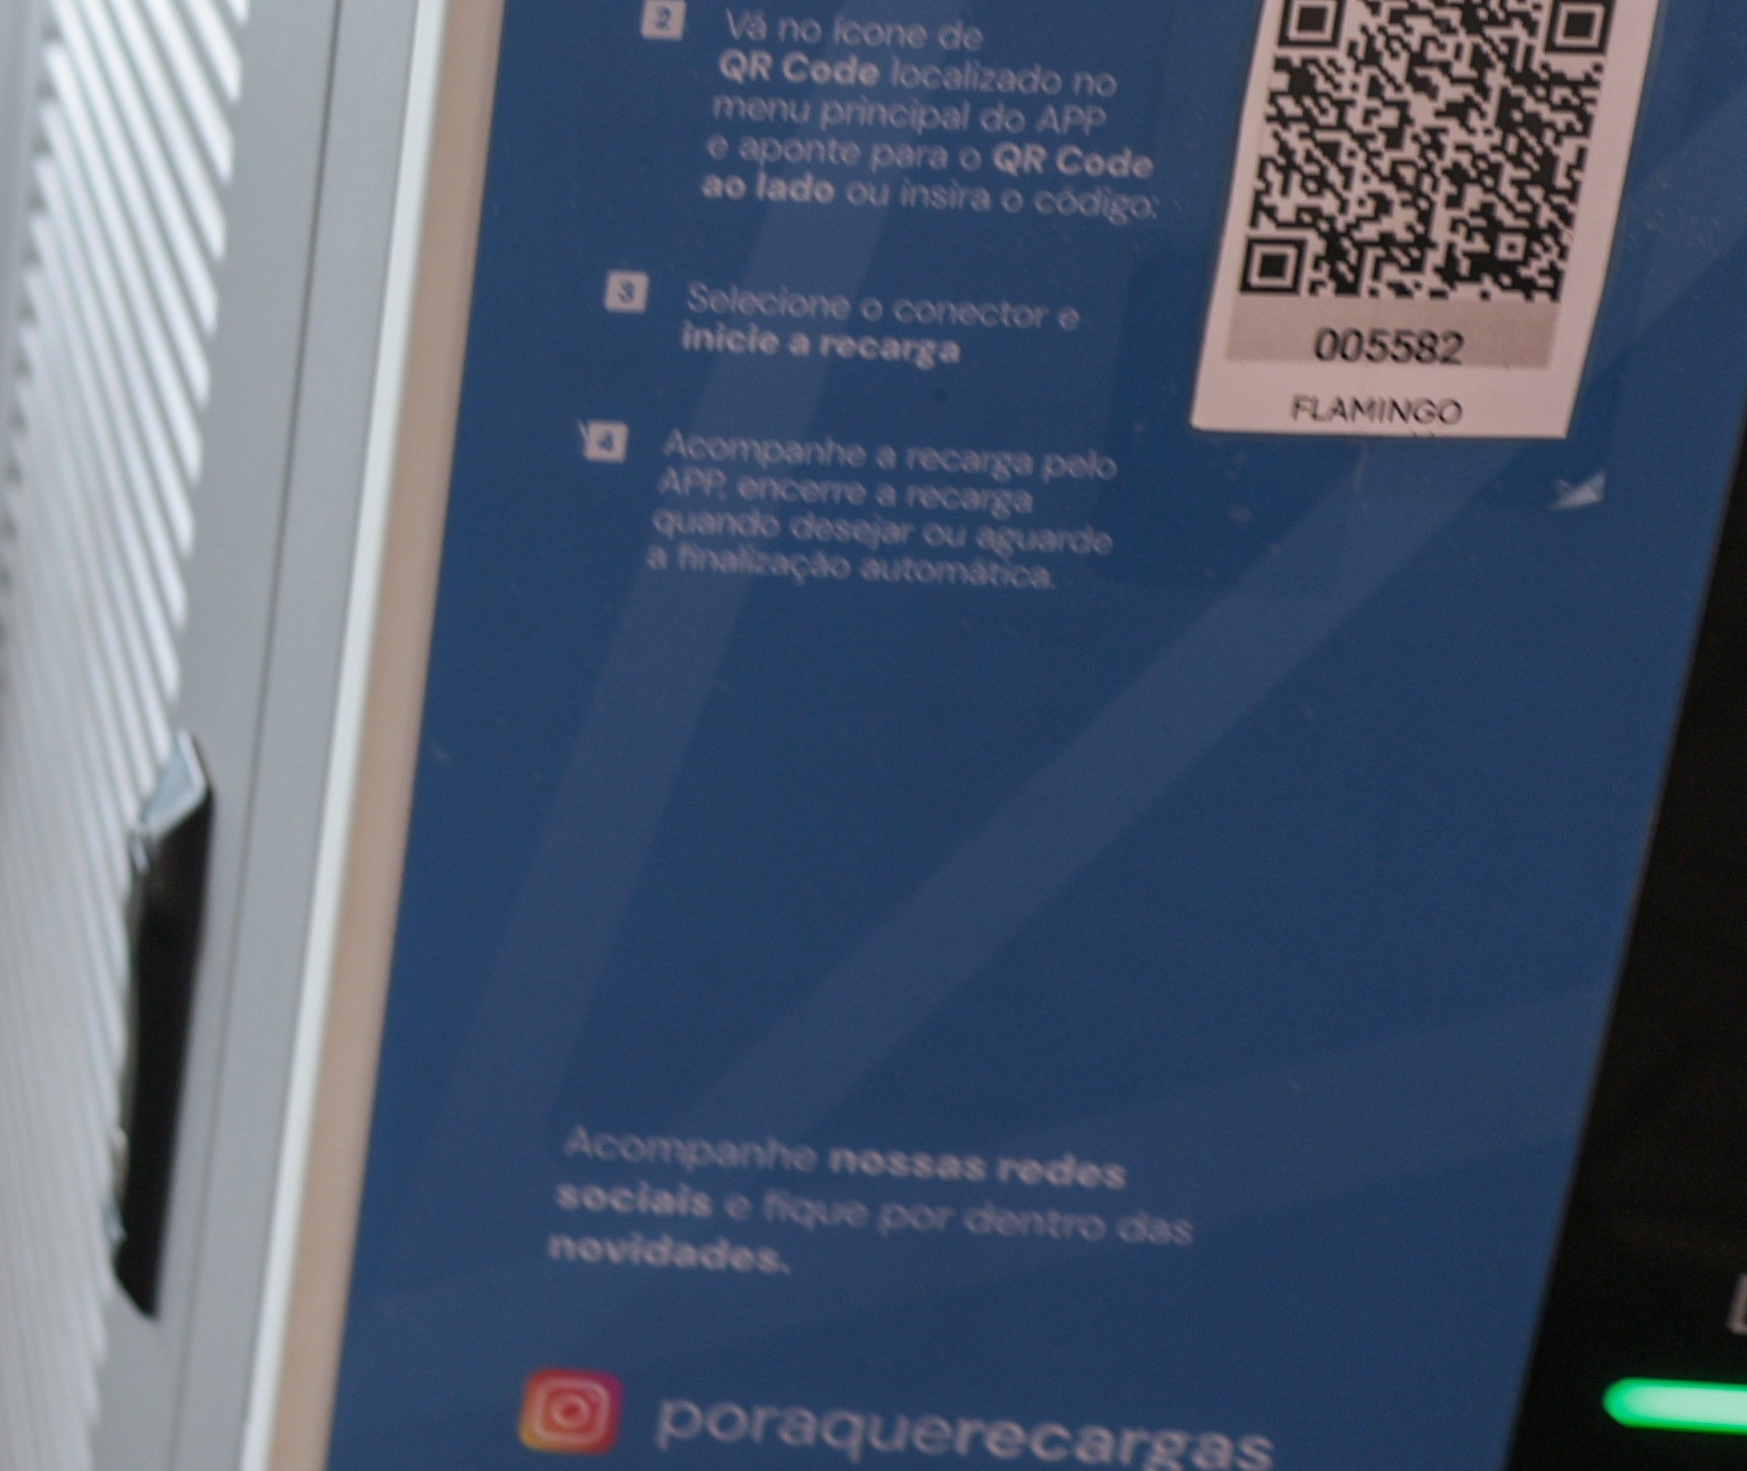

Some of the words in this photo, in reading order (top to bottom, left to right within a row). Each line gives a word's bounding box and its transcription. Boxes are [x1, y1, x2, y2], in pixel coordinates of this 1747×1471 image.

[778, 16, 821, 44] no
[939, 18, 984, 50] de
[719, 50, 772, 83] QR
[783, 53, 879, 87] Code
[891, 56, 1061, 94] localizado
[1072, 69, 1116, 97] no
[713, 96, 809, 124] menu
[820, 98, 969, 136] principal
[980, 99, 1025, 133] do
[1037, 105, 1107, 135] APP
[708, 135, 728, 160] e
[740, 136, 861, 171] aponte
[871, 139, 948, 170] para
[960, 145, 982, 169] o
[993, 143, 1046, 175] QR
[1057, 143, 1154, 179] Code
[703, 174, 746, 199] ao
[755, 169, 835, 203] lado
[847, 176, 890, 204] ou
[901, 178, 991, 211] insira
[1001, 186, 1023, 213] o
[687, 282, 849, 319] Selecione
[861, 296, 883, 321] o
[894, 295, 1048, 329] conector
[1058, 306, 1079, 329] e
[682, 321, 778, 355] inicie
[790, 331, 809, 356] a
[820, 334, 960, 370] recarga
[1314, 328, 1464, 364] 005582
[1292, 394, 1462, 424] FLAMINGO
[662, 429, 866, 470] Acompanhe
[875, 445, 896, 470] a
[906, 446, 1033, 482] recarga
[1041, 450, 1116, 482] pelo
[875, 483, 896, 507] a
[906, 484, 1033, 518] recarga
[652, 509, 781, 540] quando
[923, 522, 965, 547] ou
[646, 544, 667, 570] a
[564, 1125, 817, 1172] Acompanhe
[828, 1146, 986, 1181] nossas
[998, 1153, 1127, 1189] redes
[556, 1180, 711, 1216] sociais
[724, 1194, 751, 1219] e
[764, 1188, 868, 1234] fique
[878, 1201, 950, 1235] por
[964, 1203, 1105, 1240] dentro
[1118, 1209, 1194, 1246] das
[549, 1232, 791, 1273] novidades.
